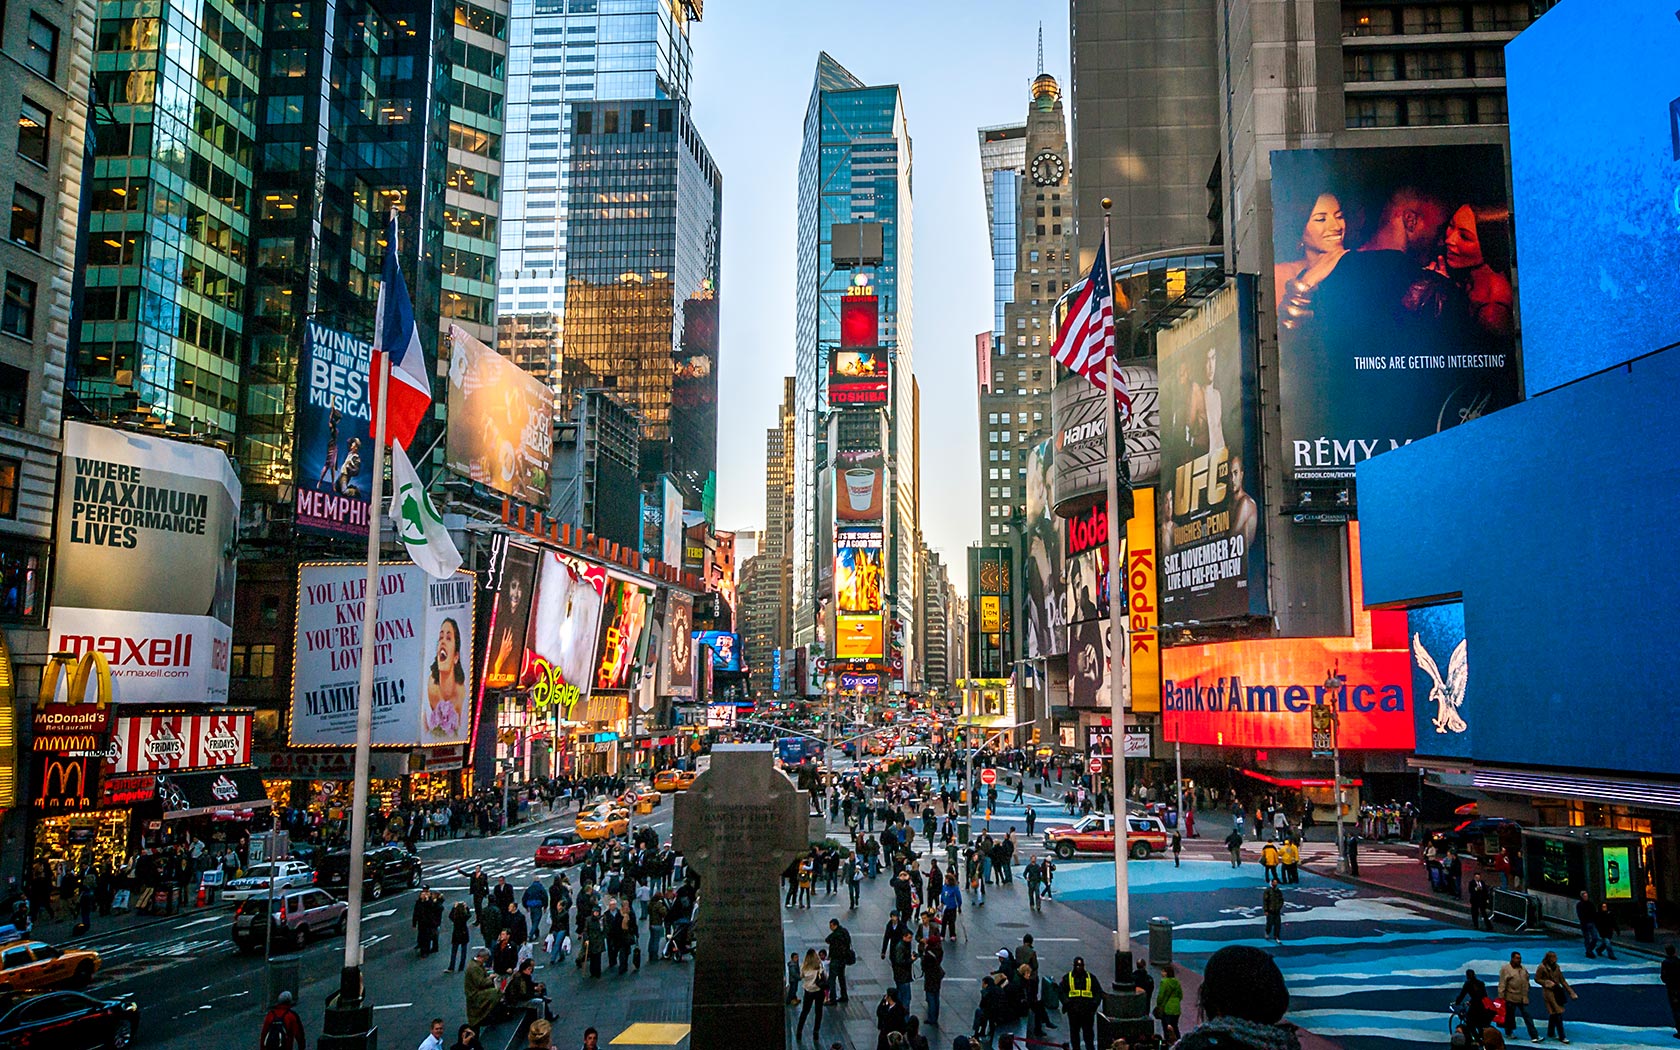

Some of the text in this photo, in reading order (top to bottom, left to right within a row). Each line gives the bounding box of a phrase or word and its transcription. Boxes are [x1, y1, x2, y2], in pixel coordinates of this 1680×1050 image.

[847, 286, 872, 296] 2010
[313, 344, 370, 375] 2010 TONY AWA
[1354, 356, 1387, 370] THINGS
[1389, 356, 1406, 369] ARE
[1408, 355, 1445, 369] GETTING
[831, 391, 887, 402] TOSHIBA
[527, 404, 549, 436] YOGI
[524, 424, 552, 458] BEAR
[1293, 437, 1378, 466] RÉMY
[75, 458, 141, 484] WHERE
[1174, 447, 1229, 516] UFC
[74, 476, 208, 519] MAXIMUM
[72, 502, 206, 535] PERFORMANCE
[1068, 502, 1109, 554] Koda
[1206, 511, 1229, 536] PENN
[70, 521, 138, 549] LIVES
[1164, 534, 1244, 575] SAT. NOVEMBER 20
[1167, 573, 1181, 591] LIVE
[1182, 570, 1191, 588] ON
[1192, 557, 1240, 586] PAY-PER-VIEW
[307, 573, 406, 606] YOU ALRADY
[430, 582, 455, 606] MAMMA
[1130, 549, 1155, 653] Kodak
[336, 599, 380, 624] KNO
[983, 610, 998, 618] LION
[983, 620, 998, 628] KING
[306, 618, 414, 651] YOU'RE ONNA
[59, 633, 192, 667] maxell
[331, 647, 362, 671] LOV
[110, 669, 189, 678] w.maxell.com
[304, 686, 362, 717] MAMM
[1165, 675, 1405, 713] Bank of America
[35, 713, 105, 724] McDonald's
[1312, 733, 1331, 741] KING
